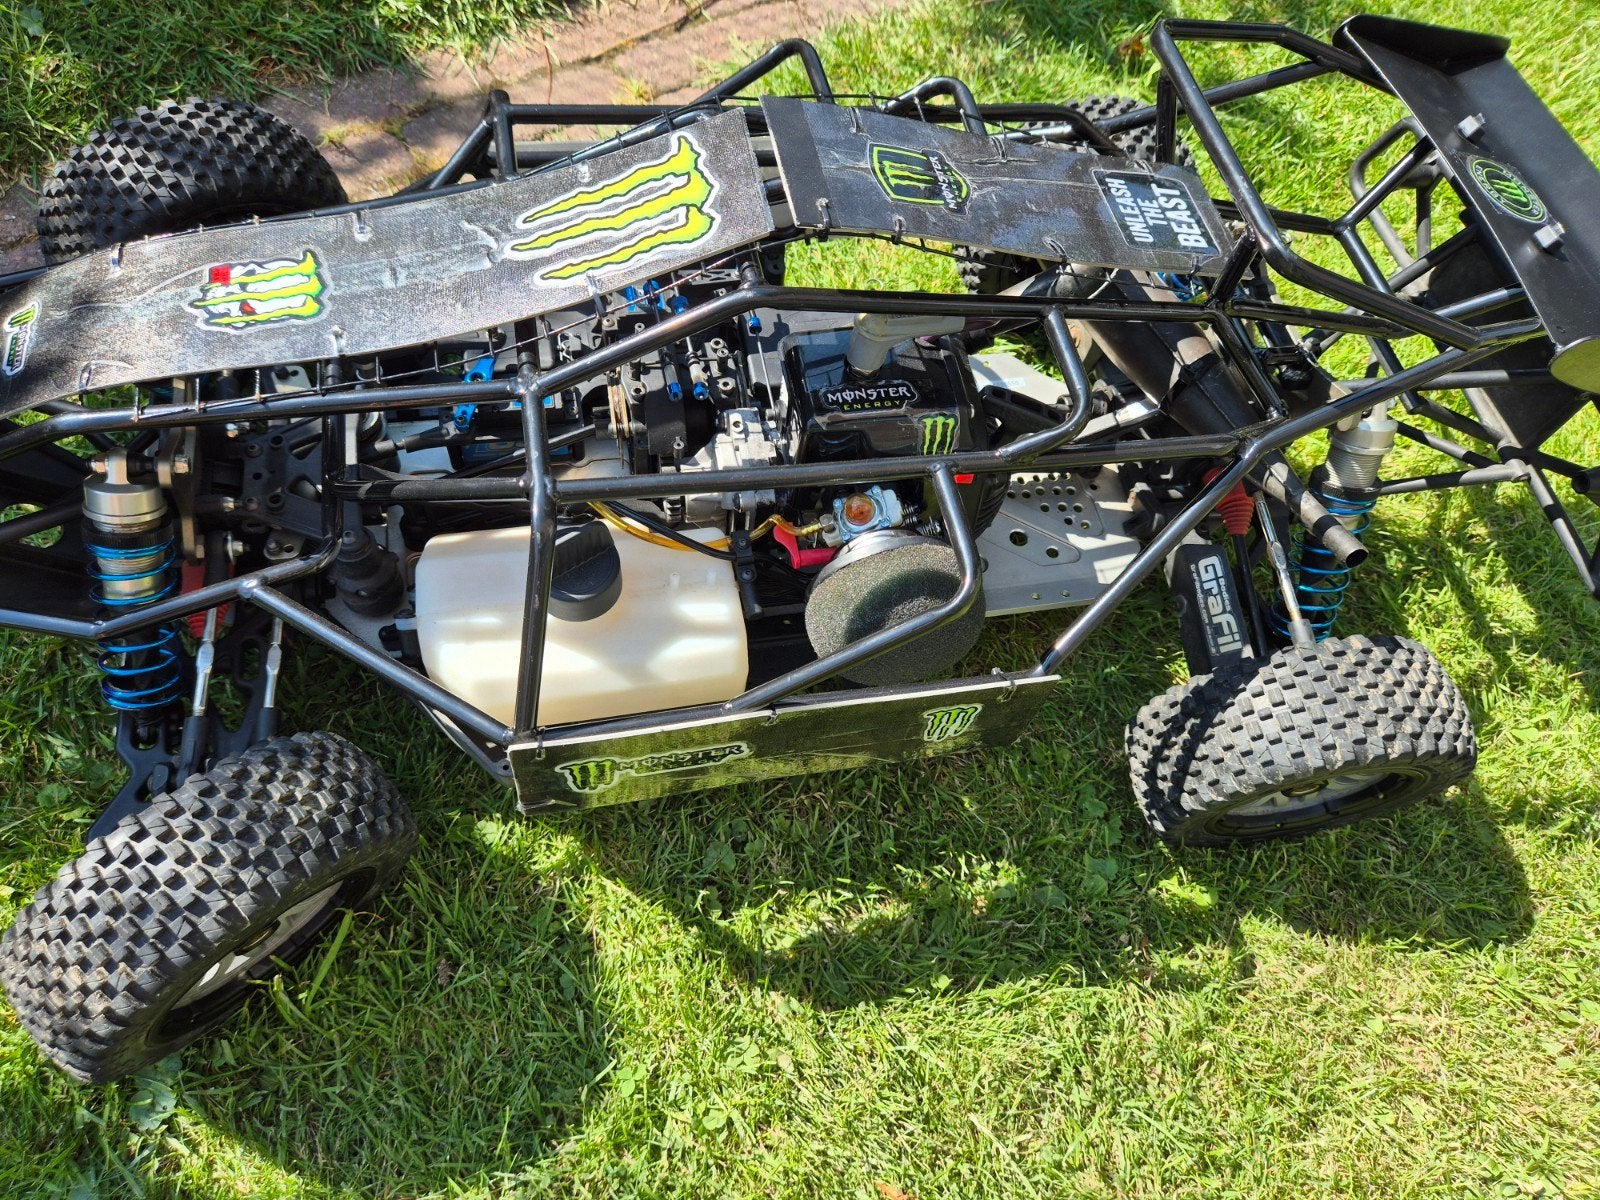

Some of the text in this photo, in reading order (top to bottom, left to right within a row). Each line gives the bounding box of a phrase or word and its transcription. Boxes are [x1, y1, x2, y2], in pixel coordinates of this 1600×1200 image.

[929, 156, 958, 209] MONSTER
[1105, 177, 1154, 243] UNLEASH
[1136, 197, 1168, 226] THE
[1150, 183, 1208, 248] BEAST
[827, 386, 911, 403] MONSTER
[843, 400, 901, 411] ENERGY
[619, 745, 741, 770] MONSTER
